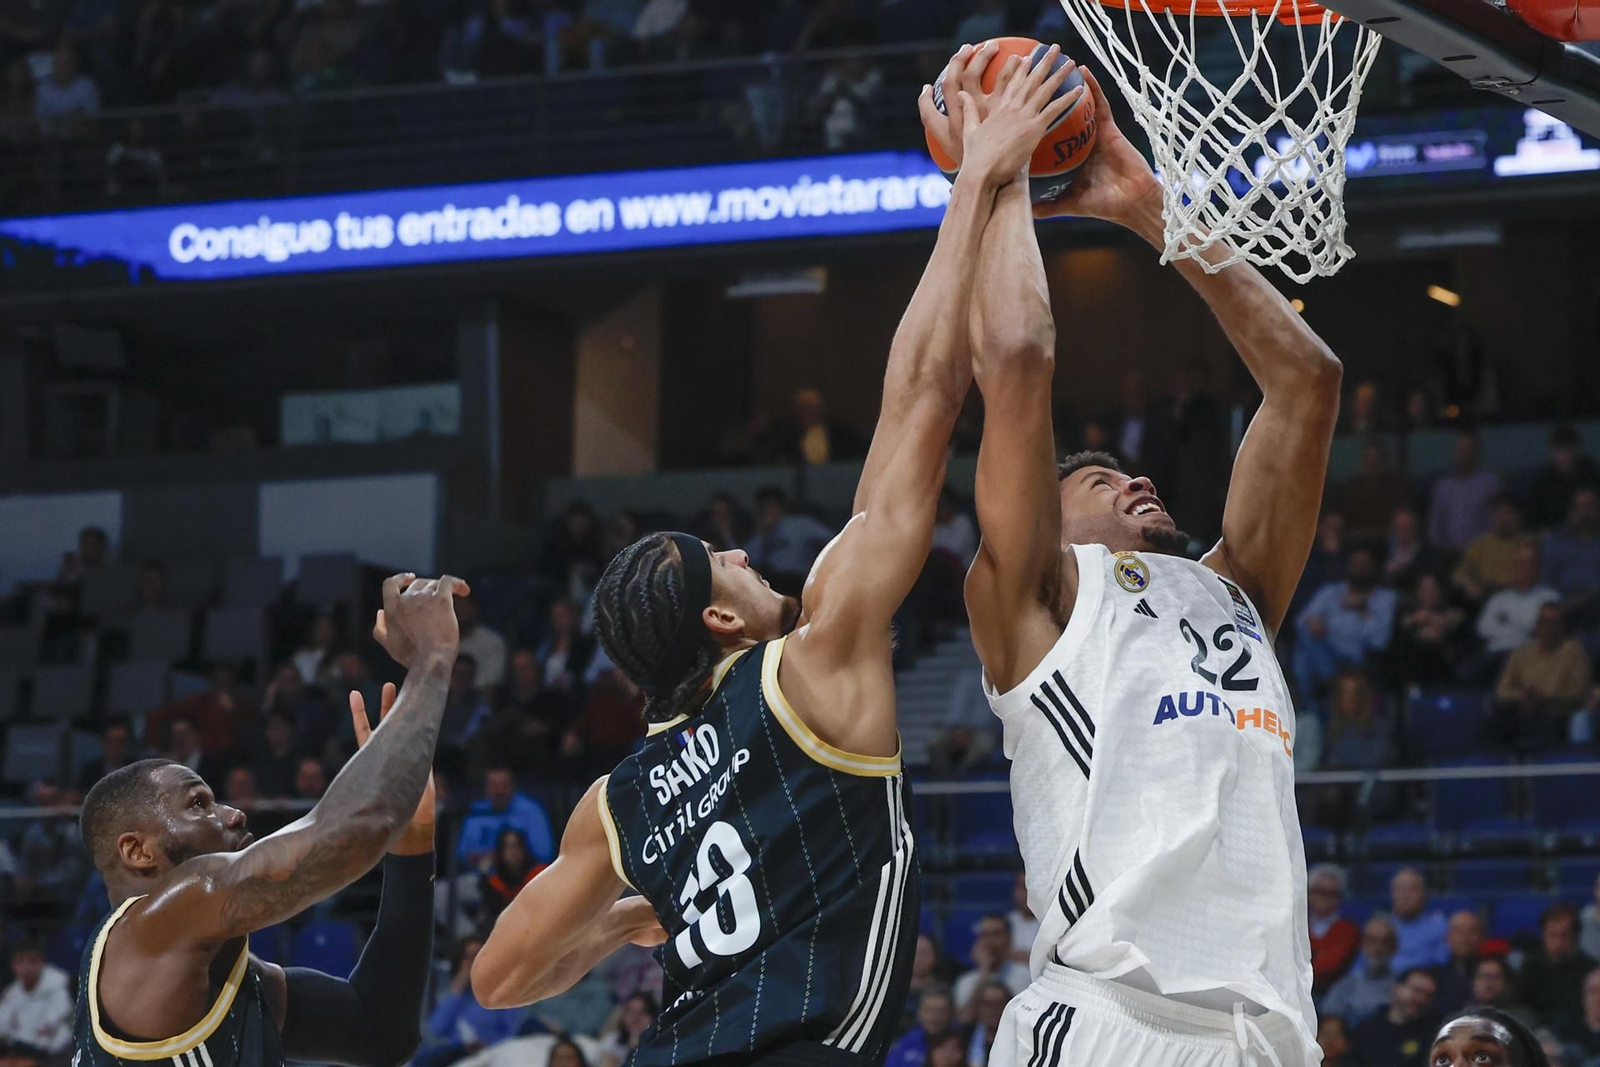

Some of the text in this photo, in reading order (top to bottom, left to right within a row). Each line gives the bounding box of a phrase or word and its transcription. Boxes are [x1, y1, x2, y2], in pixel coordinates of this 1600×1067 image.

[168, 172, 952, 263] Consigue tus entradas en www.movistarare
[1178, 618, 1260, 692] 22
[649, 723, 720, 806] SAKO
[642, 801, 696, 865] Ciril
